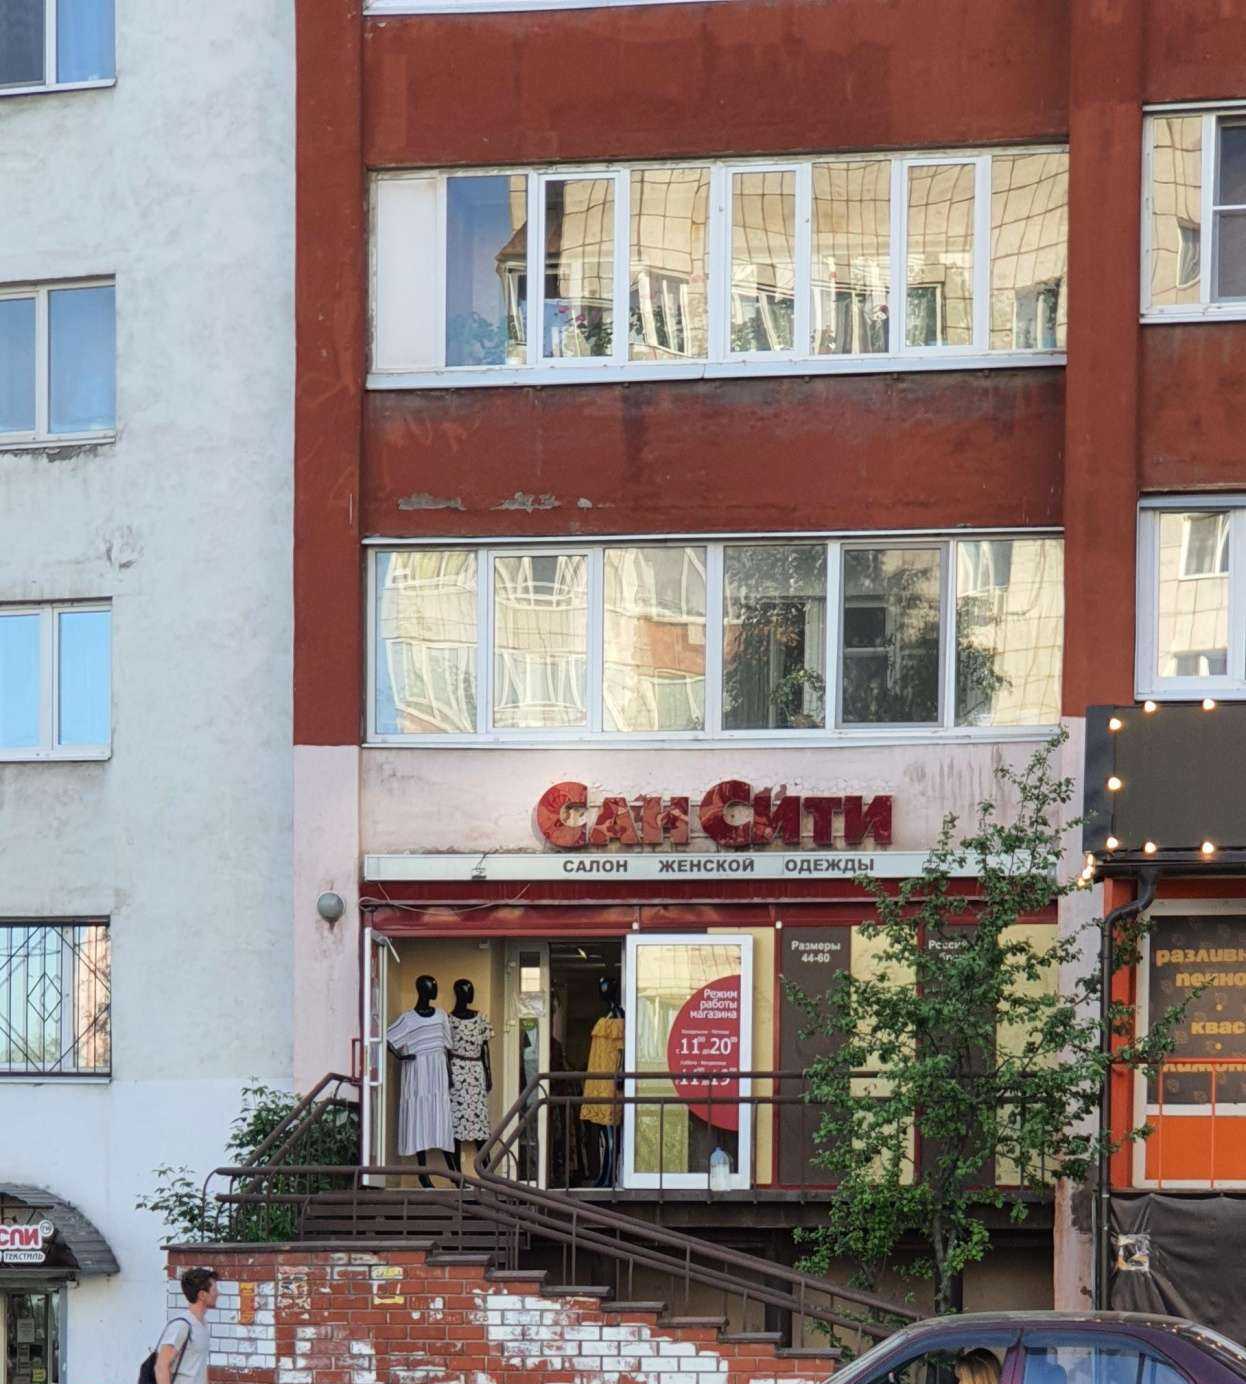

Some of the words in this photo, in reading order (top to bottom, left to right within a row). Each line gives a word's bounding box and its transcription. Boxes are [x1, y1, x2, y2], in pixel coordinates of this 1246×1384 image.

[562, 859, 629, 873] САЛОН
[658, 857, 755, 873] ЖЕНСКОЙ
[784, 858, 875, 873] ОДЕЖДЫ
[791, 940, 841, 952] Размеры
[801, 952, 830, 963] 44-60
[704, 989, 737, 999] Режим
[700, 998, 738, 1010] работы
[690, 1010, 738, 1019] магазина
[1191, 1021, 1245, 1034] квас
